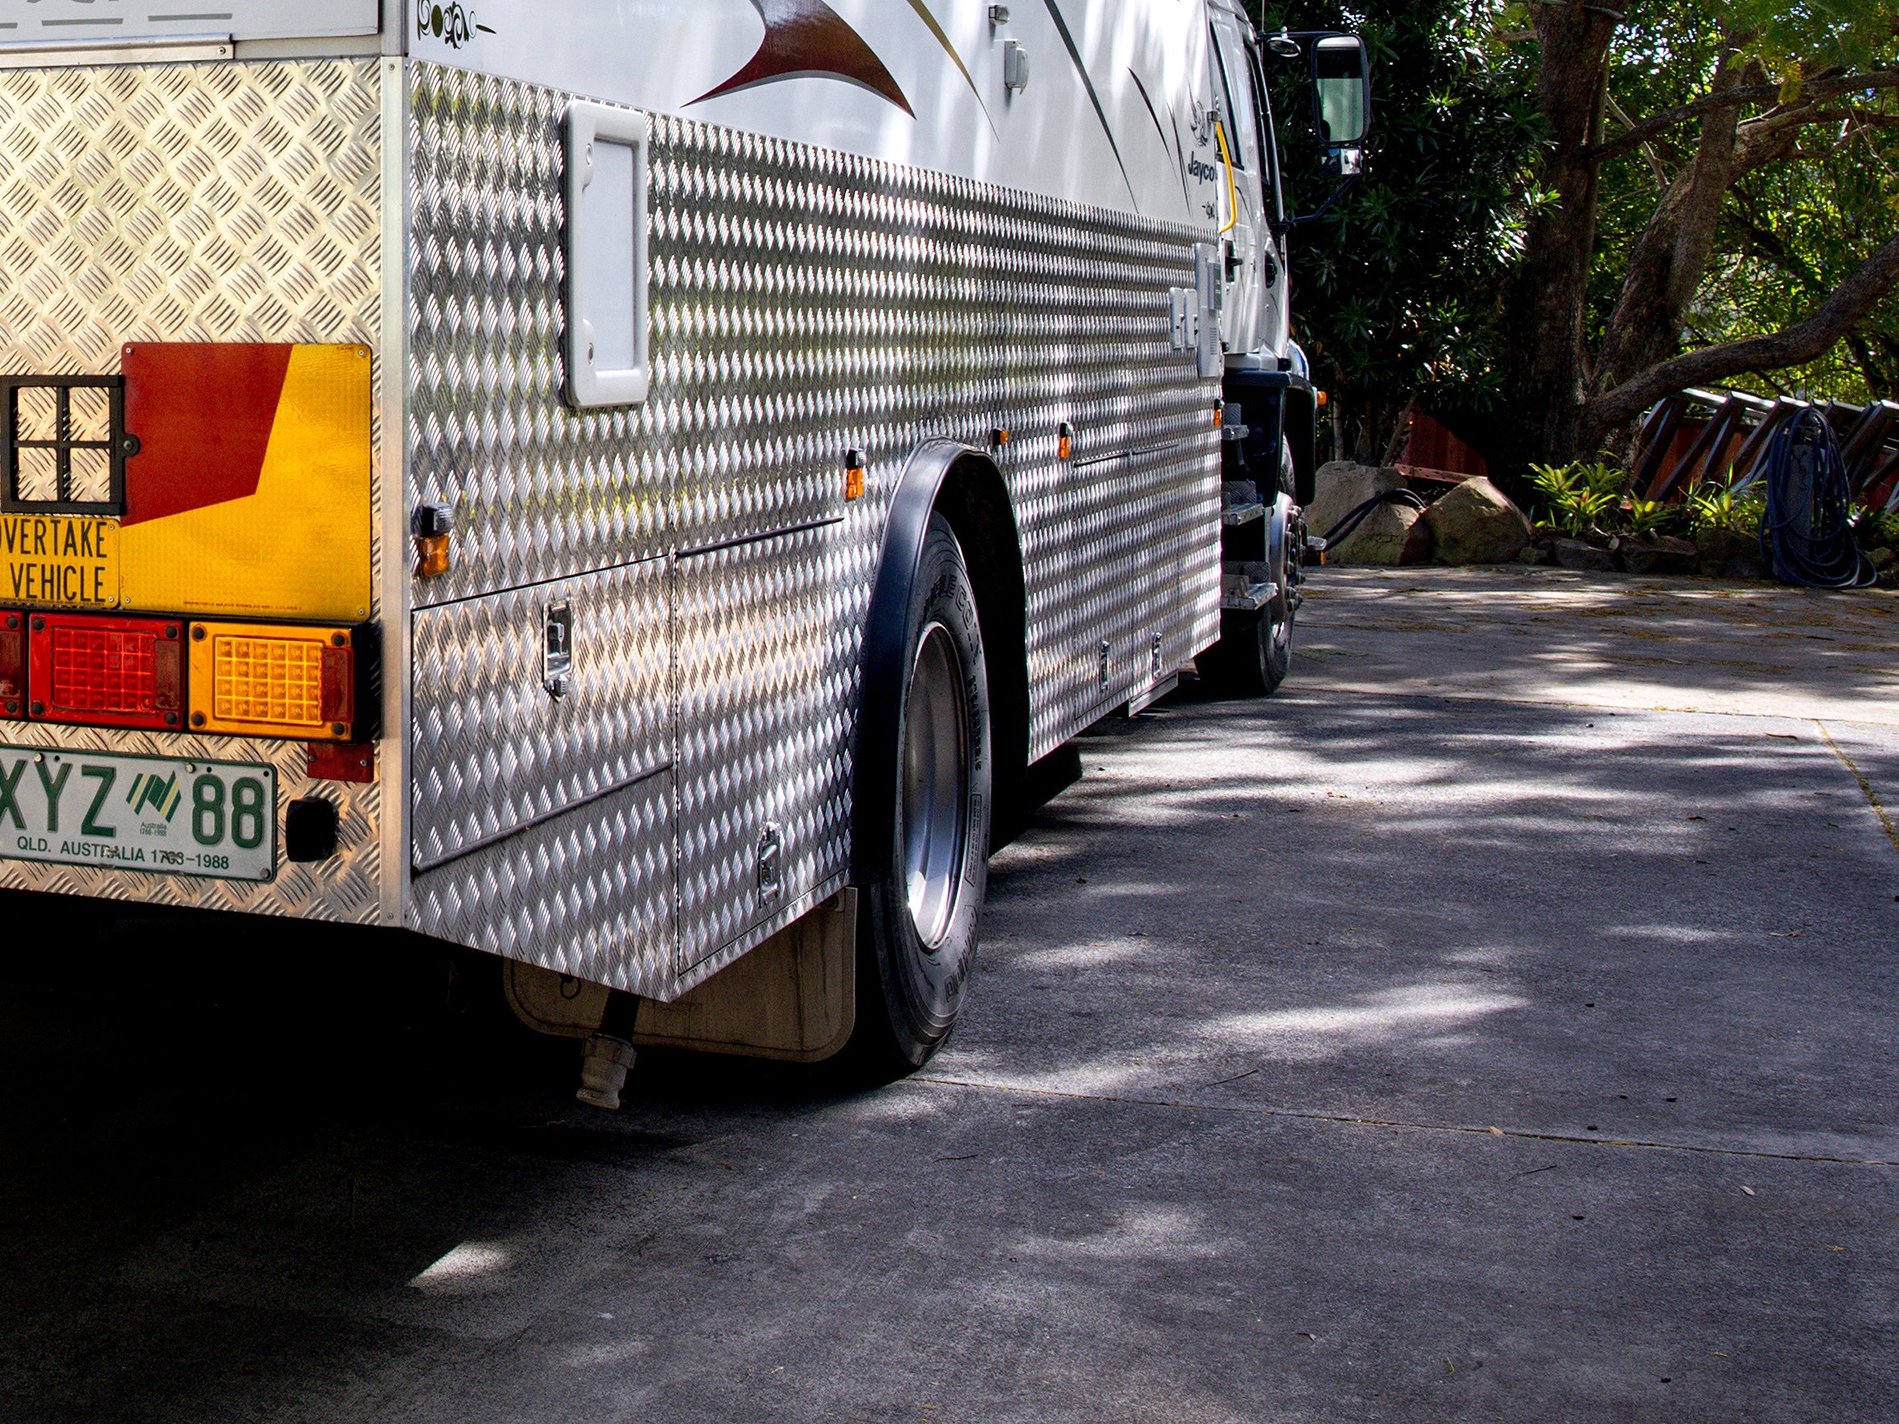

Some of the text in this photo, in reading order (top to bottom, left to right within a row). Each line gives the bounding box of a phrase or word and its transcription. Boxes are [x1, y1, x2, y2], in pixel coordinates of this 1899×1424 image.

[1187, 150, 1215, 185] Jayco
[10, 562, 106, 604] VEHICLE
[191, 773, 264, 850] 88
[17, 836, 51, 853] QLD.
[60, 840, 145, 862] AUSTRALIA
